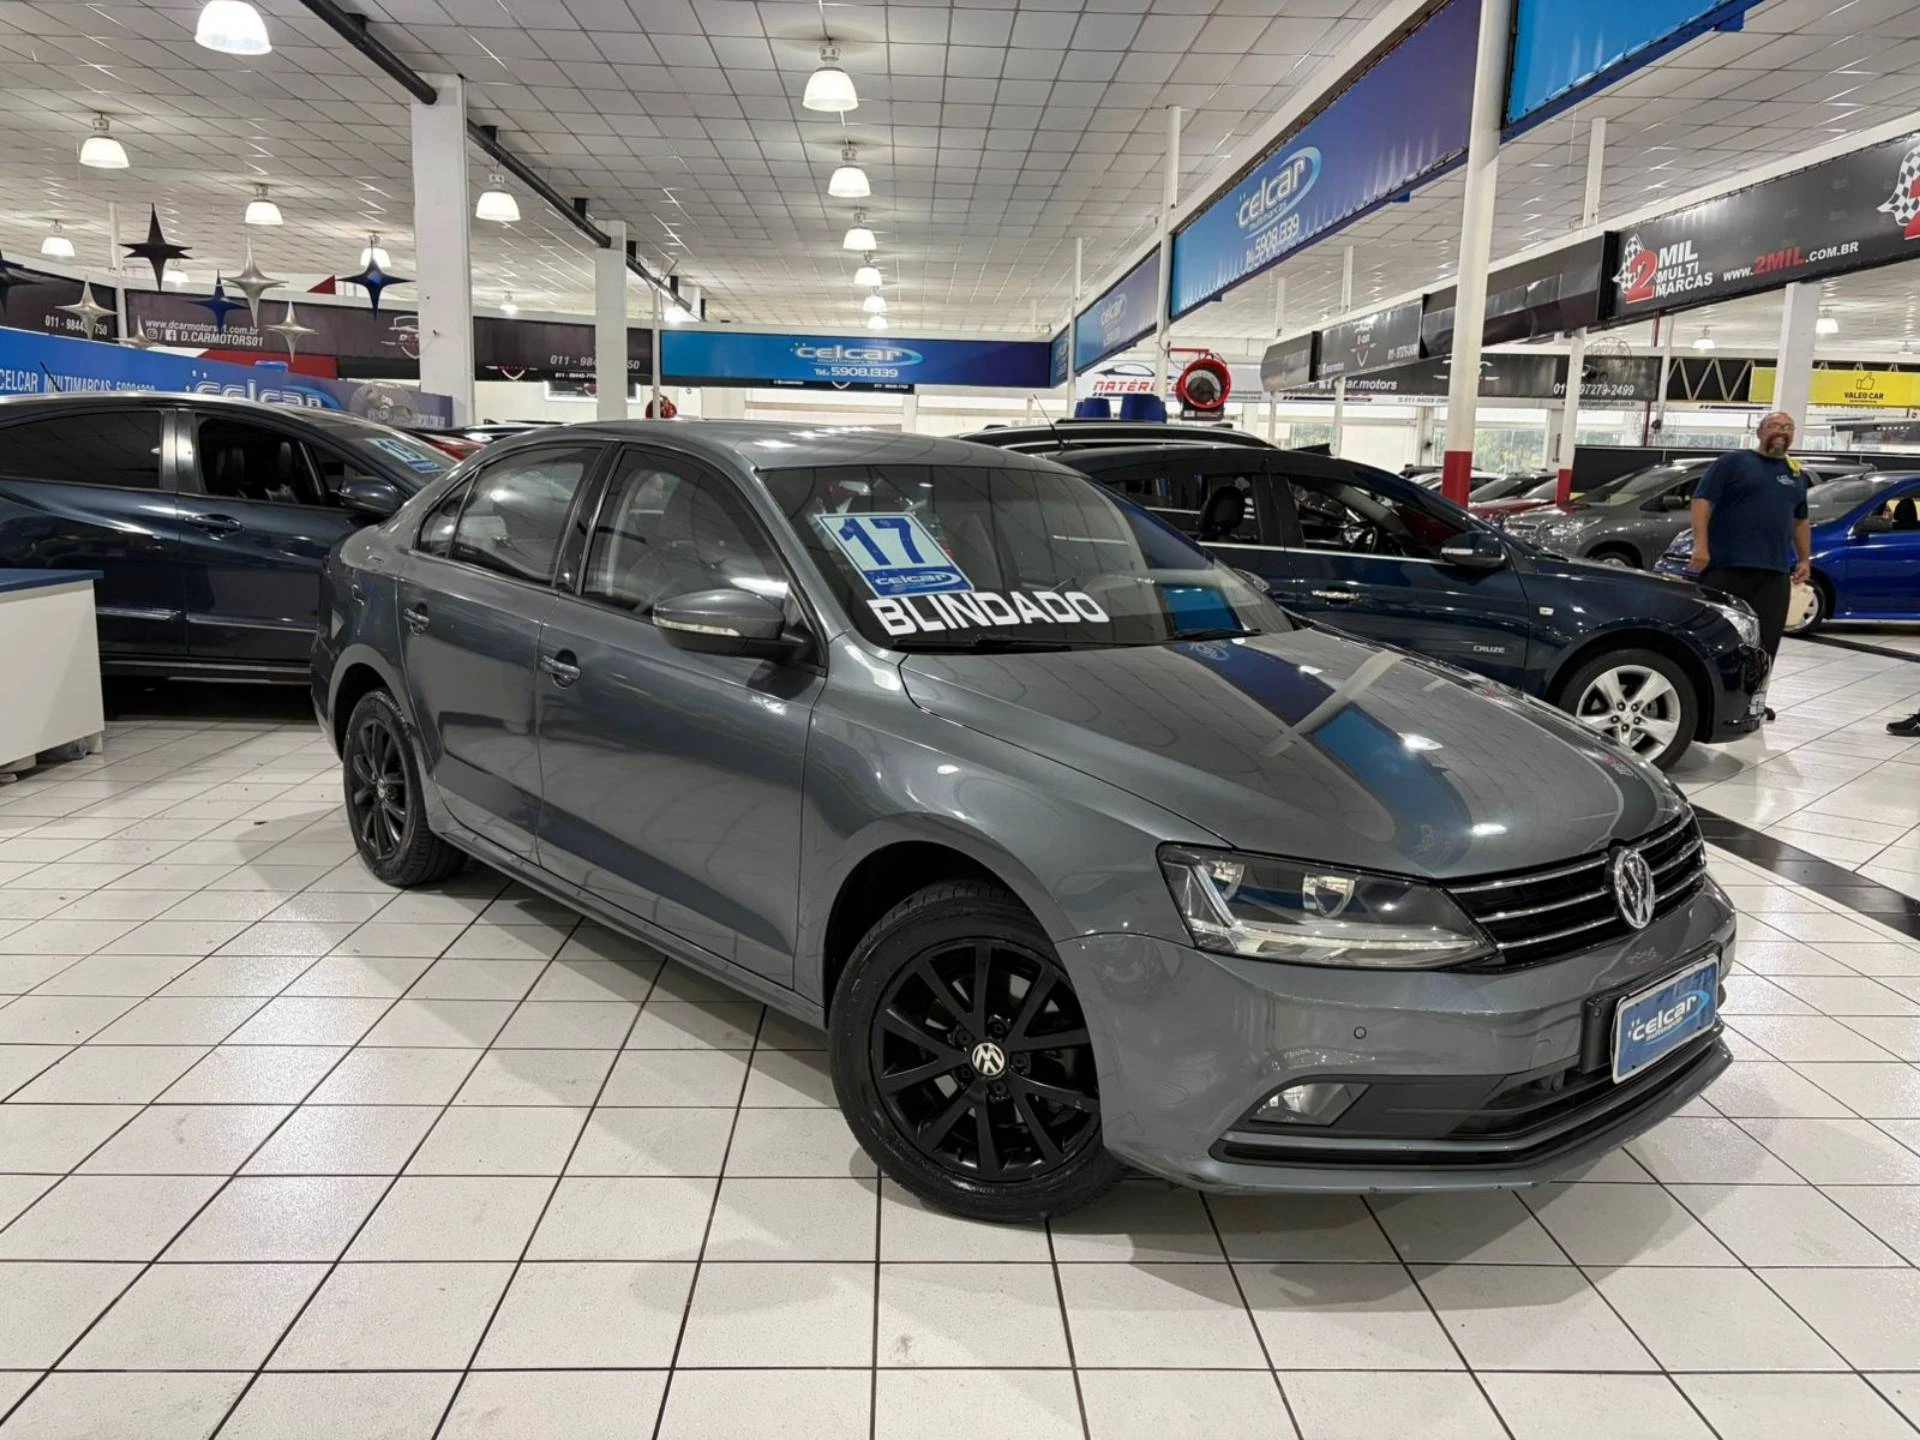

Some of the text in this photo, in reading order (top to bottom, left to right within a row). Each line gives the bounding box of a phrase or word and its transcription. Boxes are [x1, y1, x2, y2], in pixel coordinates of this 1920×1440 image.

[1658, 240, 1699, 269] MIL
[1625, 249, 1658, 304] 2
[1655, 261, 1700, 284] MULTI
[1655, 271, 1714, 298] MARCAS
[550, 354, 569, 366] 011
[795, 344, 902, 361] celcar
[0, 367, 39, 393] CELCAR
[1869, 392, 1884, 400] CAR
[838, 517, 924, 566] 17
[865, 590, 1110, 636] BLINDADO
[1473, 644, 1505, 654] CRUZE
[1631, 994, 1698, 1041] celcar
